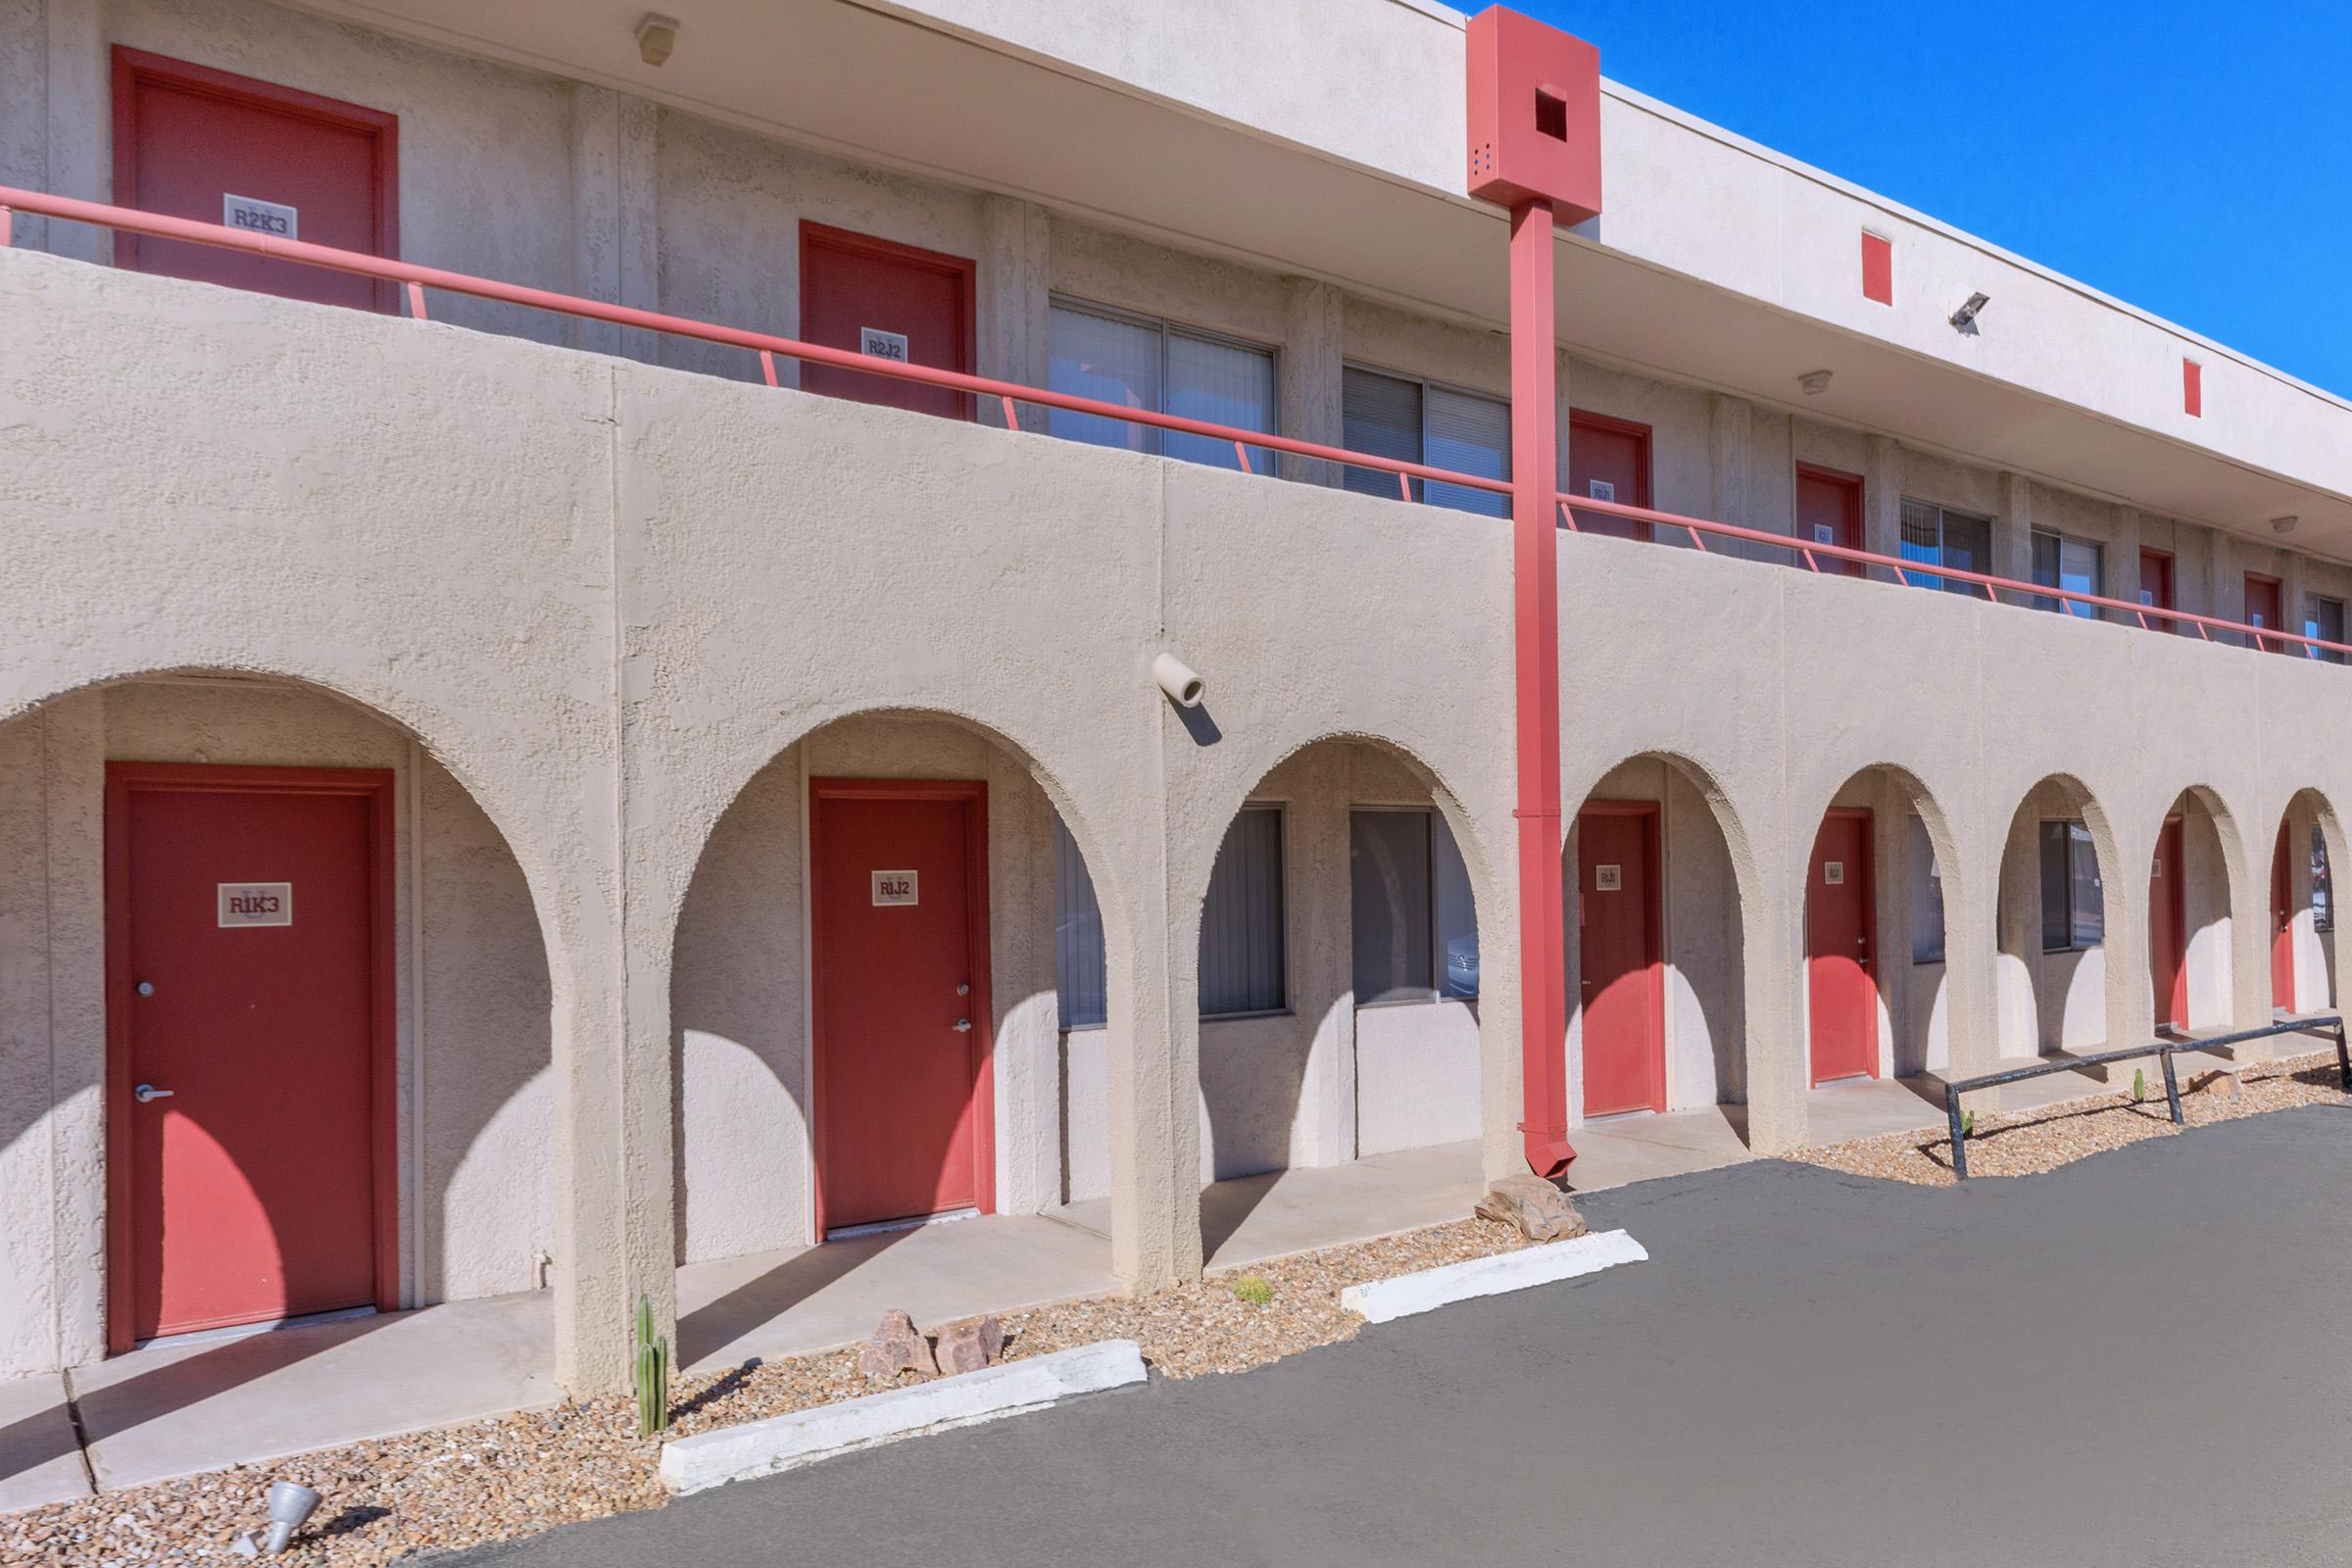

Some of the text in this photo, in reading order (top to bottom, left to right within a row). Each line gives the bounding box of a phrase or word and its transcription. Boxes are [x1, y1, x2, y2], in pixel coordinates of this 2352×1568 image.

[234, 209, 287, 233] R2K3
[869, 339, 901, 359] R2J2
[880, 881, 910, 895] R1J2
[229, 896, 279, 913] R1K3
